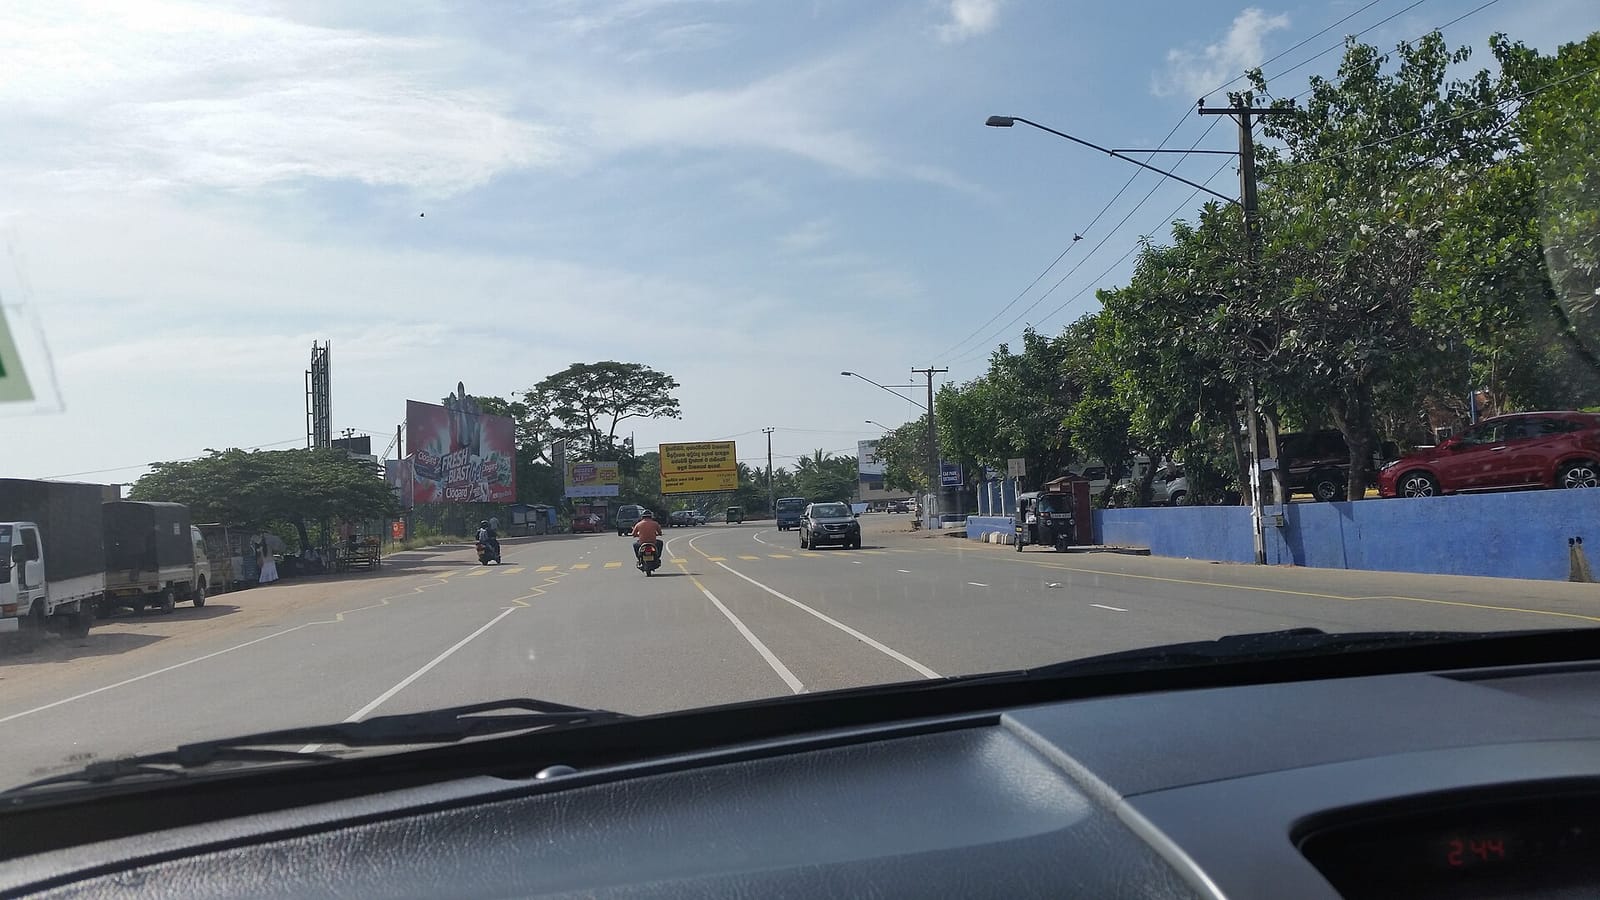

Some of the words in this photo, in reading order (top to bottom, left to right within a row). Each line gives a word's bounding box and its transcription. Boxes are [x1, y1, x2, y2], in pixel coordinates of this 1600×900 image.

[442, 448, 468, 471] FRESH
[448, 465, 470, 483] BLAST
[445, 486, 468, 500] Clogard
